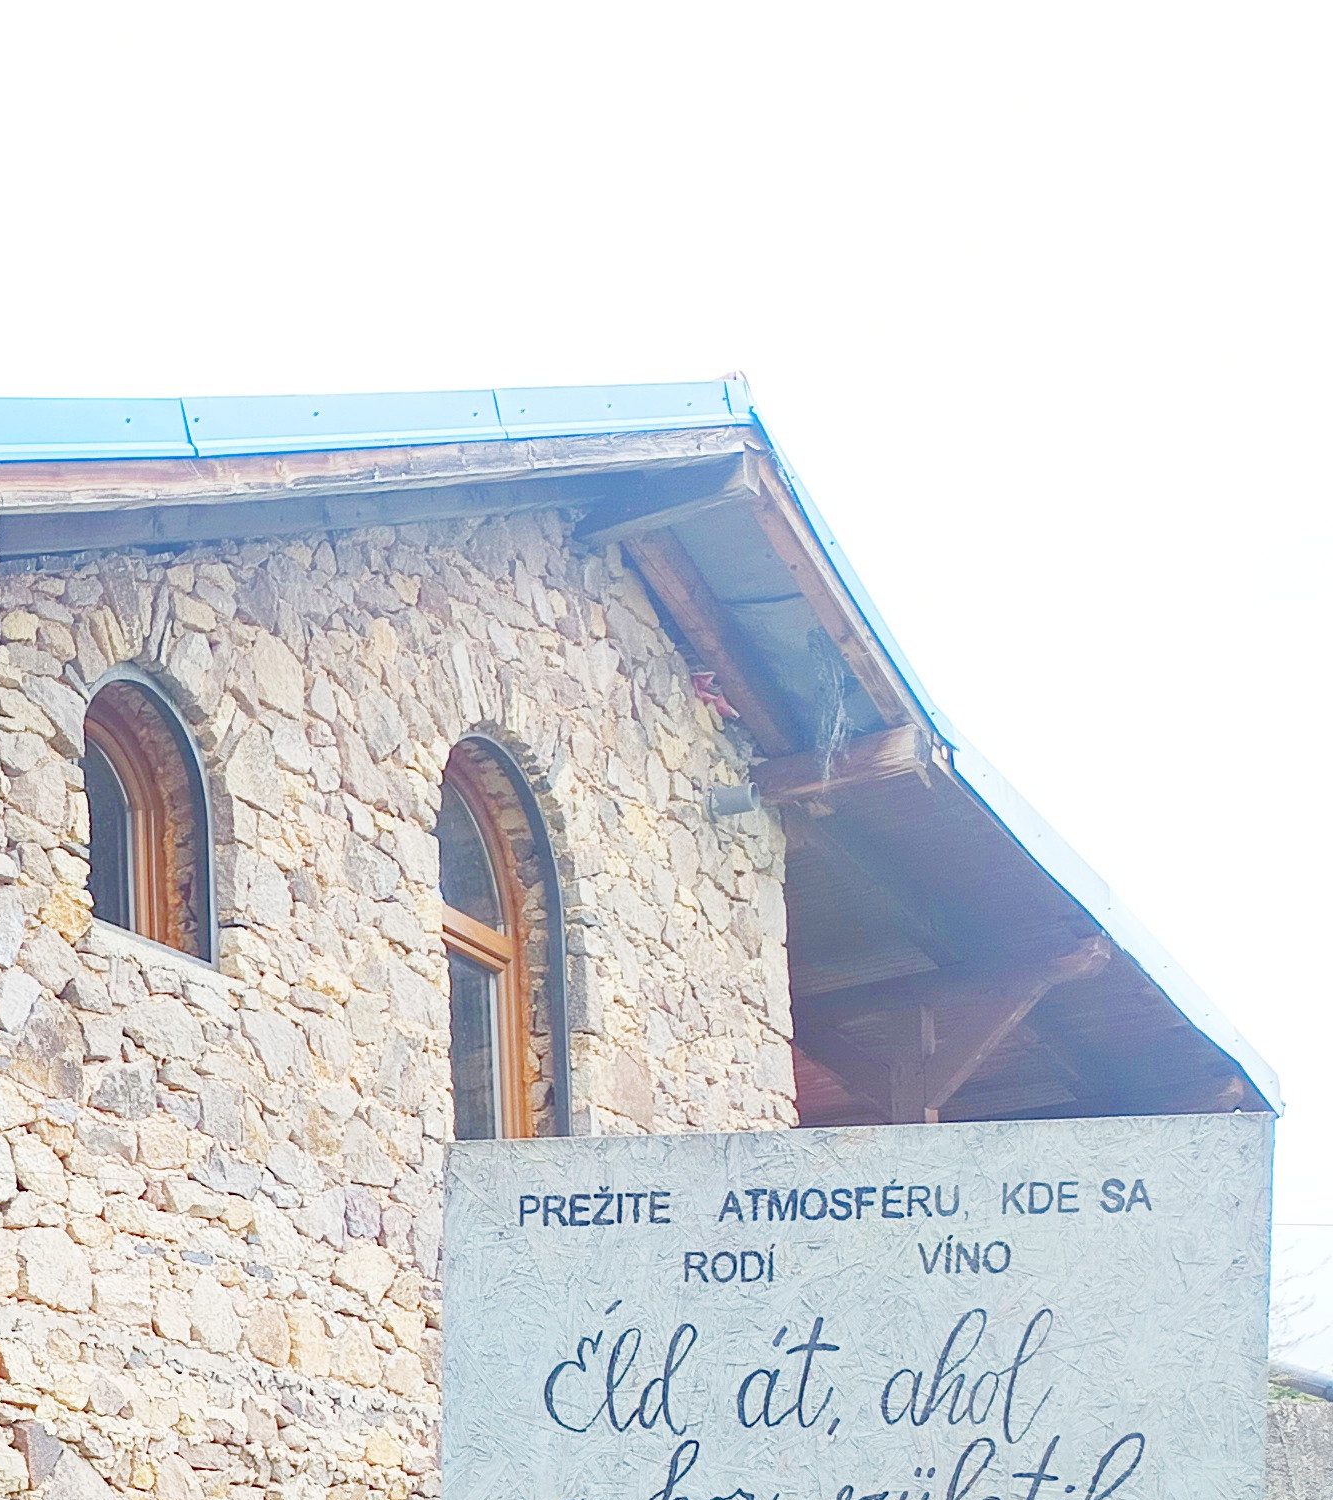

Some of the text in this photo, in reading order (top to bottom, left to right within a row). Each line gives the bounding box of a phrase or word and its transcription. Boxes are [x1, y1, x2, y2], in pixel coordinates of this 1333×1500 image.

[518, 1177, 1153, 1227] PREŽITE ATMOSFÉRU, KDE SA
[683, 1233, 1012, 1284] RODÍ VÍNO
[543, 1299, 1054, 1445] Éld át, ahol
